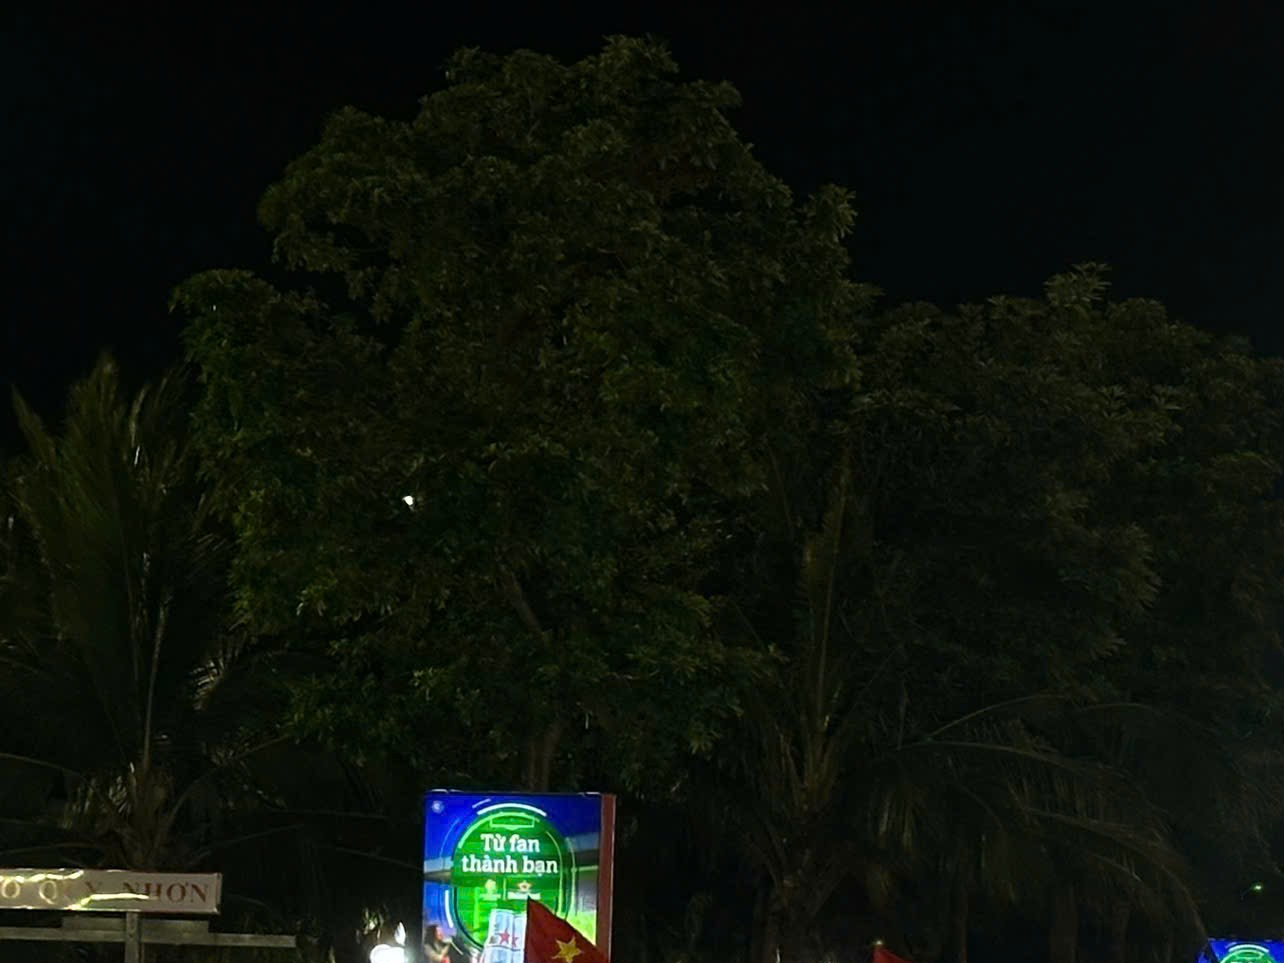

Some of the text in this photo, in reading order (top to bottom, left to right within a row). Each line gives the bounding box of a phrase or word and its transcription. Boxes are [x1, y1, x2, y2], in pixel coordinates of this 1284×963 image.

[480, 832, 540, 853] Từ fan
[462, 855, 558, 877] thành bạn
